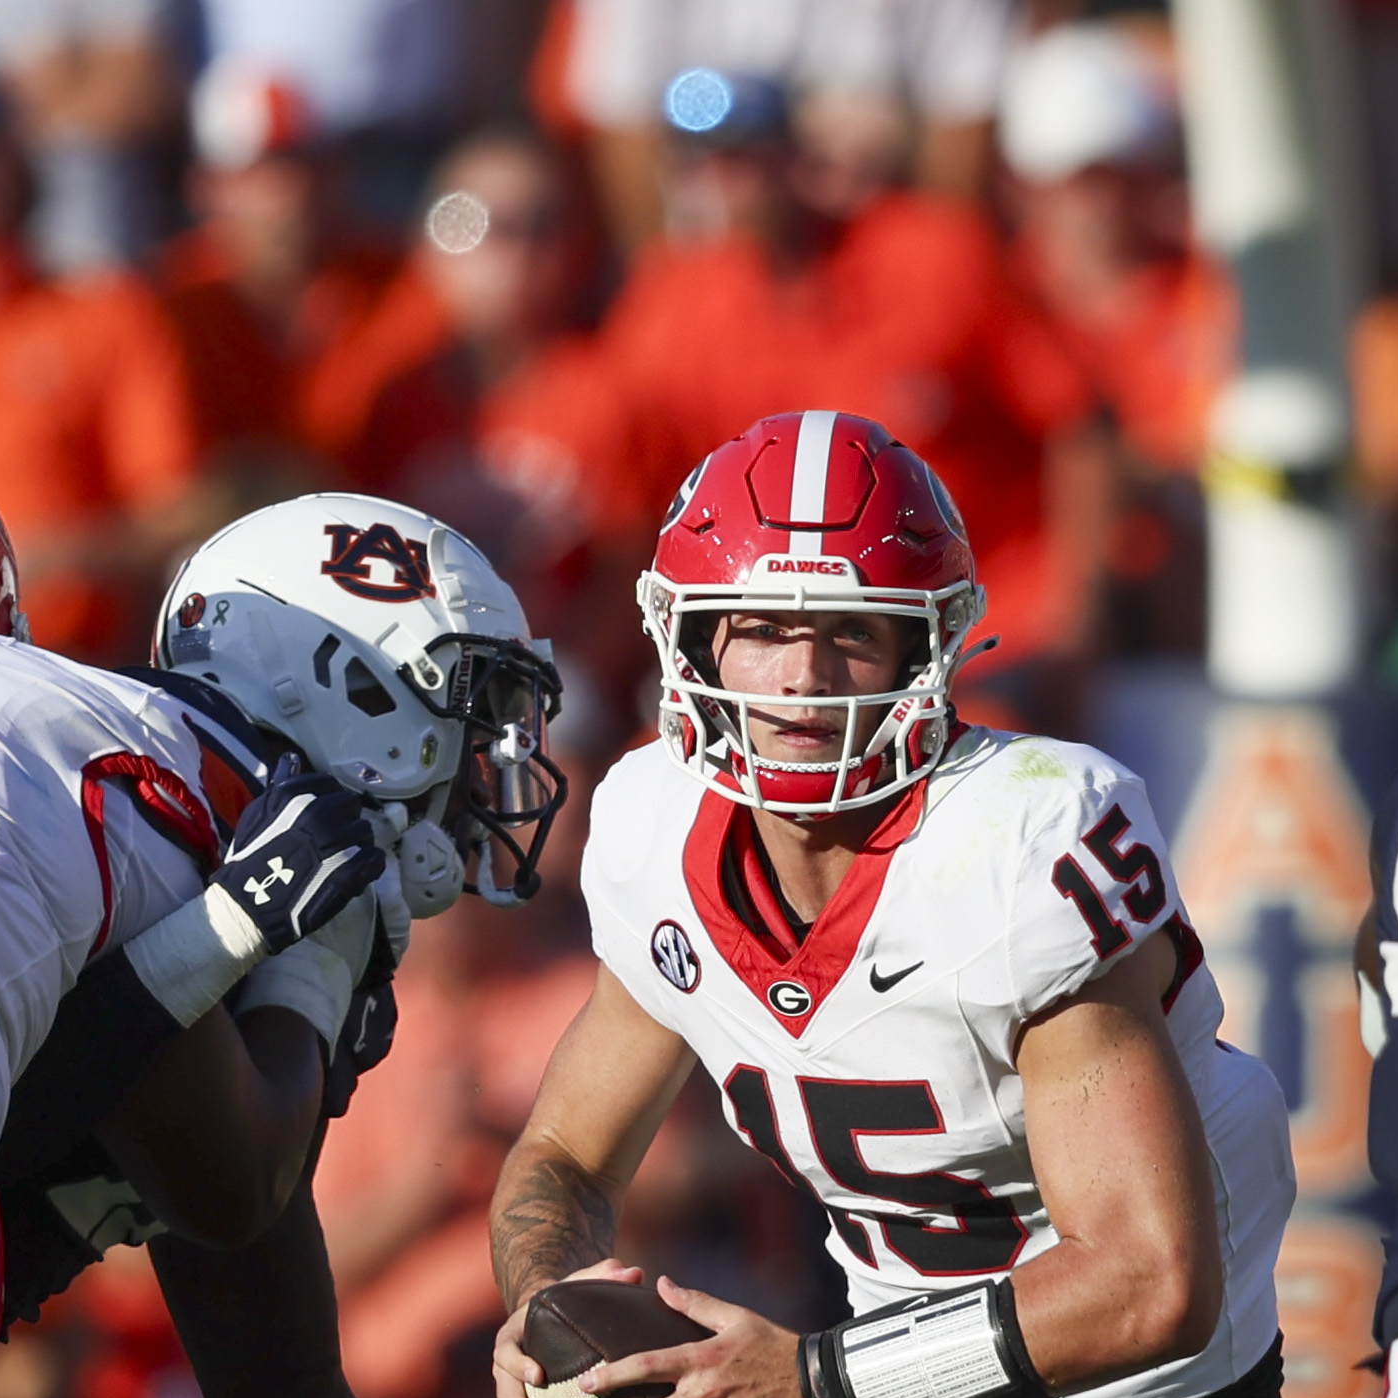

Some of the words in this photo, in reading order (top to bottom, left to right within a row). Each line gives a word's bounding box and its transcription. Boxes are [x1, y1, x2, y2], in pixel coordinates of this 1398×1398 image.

[767, 559, 848, 577] DAWGS
[1051, 802, 1167, 962] 15
[653, 922, 699, 992] SEC
[722, 1062, 1030, 1277] 15
